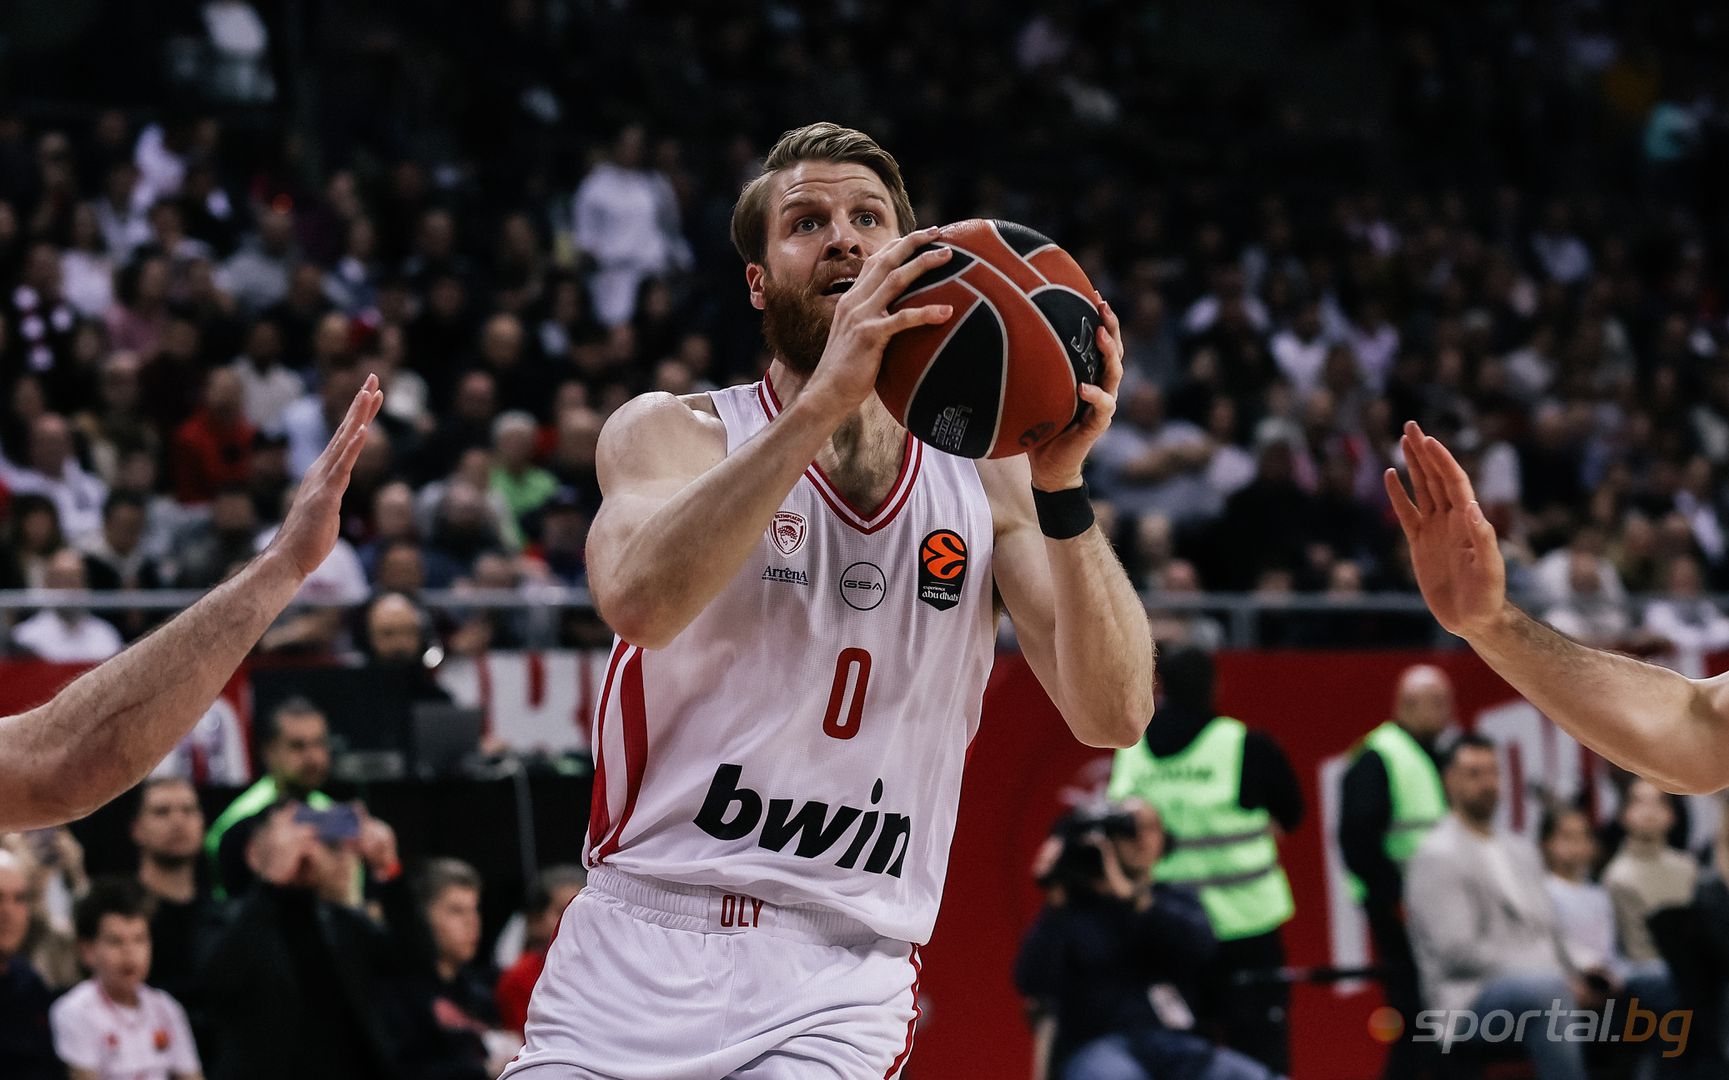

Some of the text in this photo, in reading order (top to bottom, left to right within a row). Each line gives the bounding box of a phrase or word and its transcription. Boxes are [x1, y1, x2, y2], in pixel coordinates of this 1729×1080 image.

[843, 580, 883, 592] GSA
[922, 590, 939, 599] abu
[822, 647, 872, 740] 0
[692, 763, 911, 879] bwin
[720, 895, 764, 929] OLY
